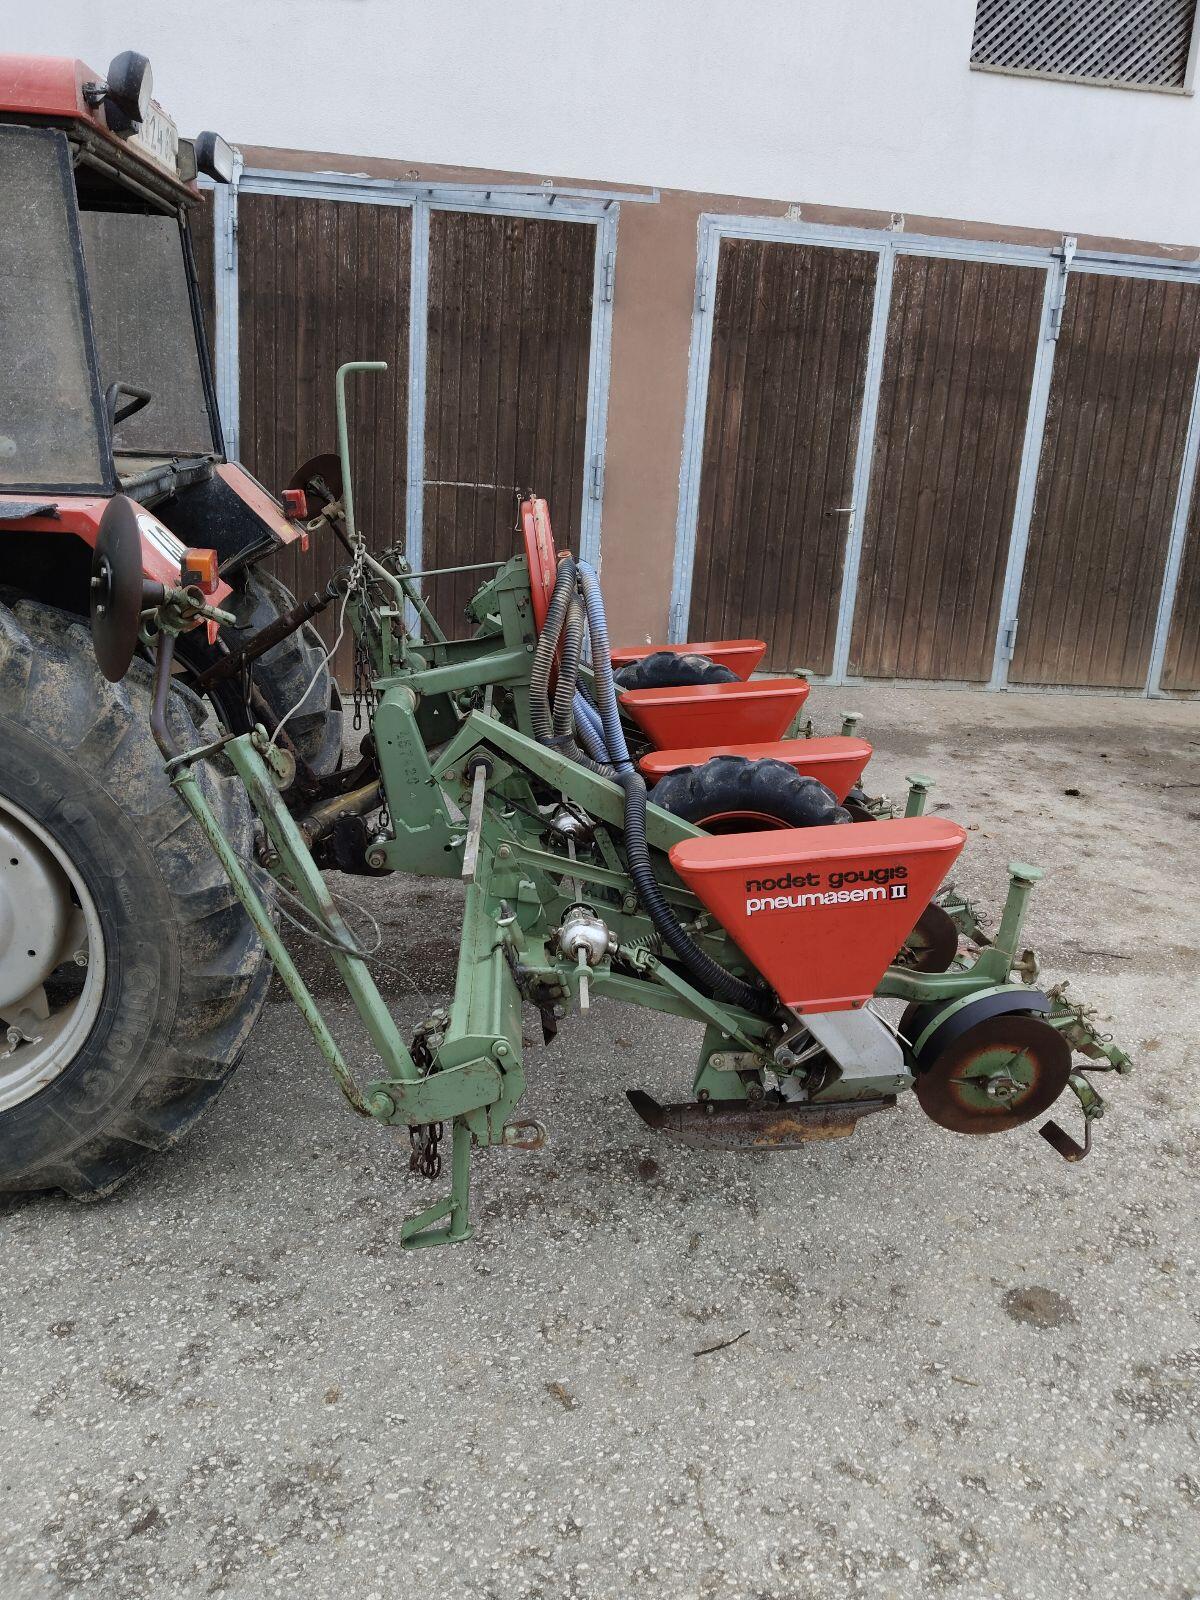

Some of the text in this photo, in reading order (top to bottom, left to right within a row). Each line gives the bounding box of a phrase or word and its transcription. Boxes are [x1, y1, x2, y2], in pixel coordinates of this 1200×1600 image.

[746, 865, 908, 892] nodet gougis
[746, 884, 907, 915] pneumasem II
